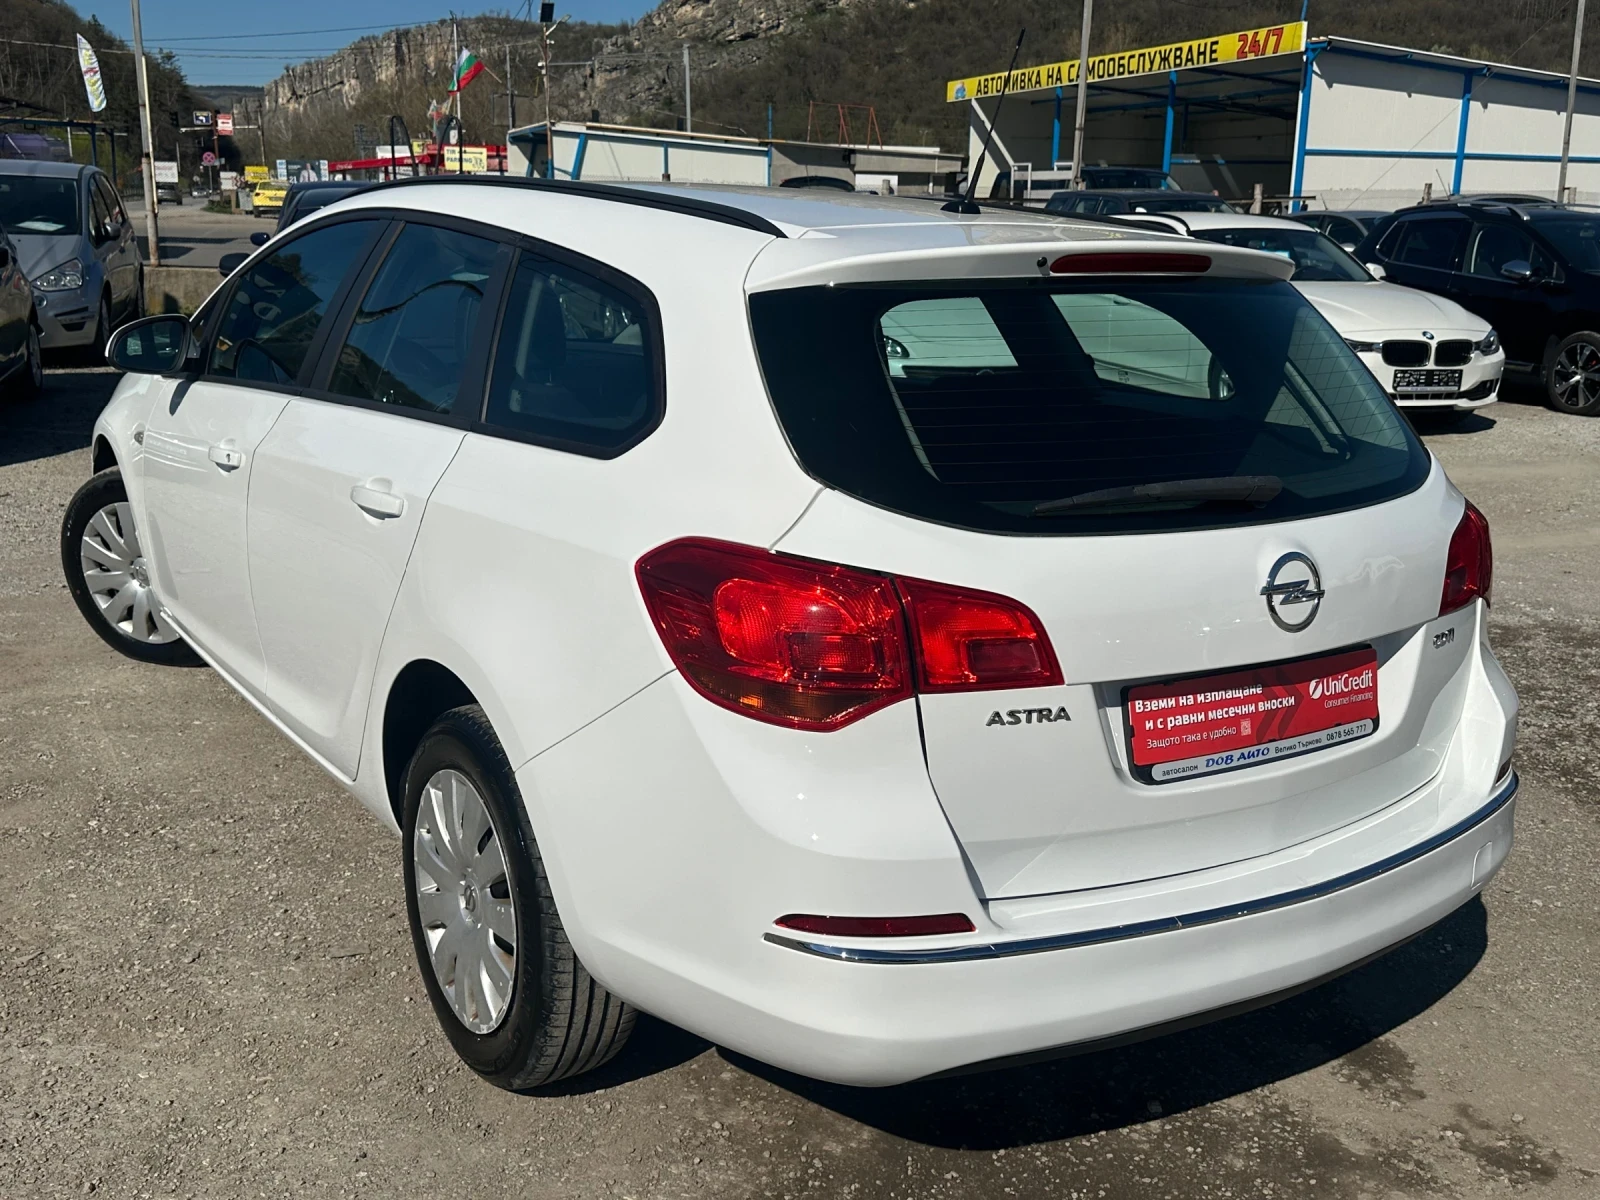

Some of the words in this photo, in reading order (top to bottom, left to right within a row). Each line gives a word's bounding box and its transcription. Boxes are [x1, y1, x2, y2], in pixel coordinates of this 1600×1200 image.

[975, 69, 1042, 96] АВТОМИВКА
[1046, 66, 1063, 86] НА
[1237, 27, 1284, 60] 24/7
[1323, 669, 1373, 696] UniCredit
[1135, 697, 1176, 713] Вземи
[1179, 695, 1194, 706] на
[1197, 684, 1263, 704] изплащане
[1324, 696, 1349, 708] Consumer
[1350, 692, 1373, 703] Financing
[985, 706, 1072, 726] ASTRA
[1145, 719, 1154, 730] и
[1157, 718, 1164, 729] с
[1167, 711, 1205, 730] равни
[1208, 703, 1256, 720] месечни
[1258, 696, 1295, 711] вноски
[1146, 736, 1180, 749] Защото
[1183, 733, 1201, 743] така
[1203, 732, 1208, 740] е
[1210, 726, 1237, 740] удобно
[1162, 764, 1199, 777] автосалон
[1274, 744, 1297, 754] Велико
[1298, 738, 1322, 748] Търново
[1326, 731, 1342, 742] 0878
[1343, 727, 1355, 737] 565
[1356, 723, 1367, 734] 777
